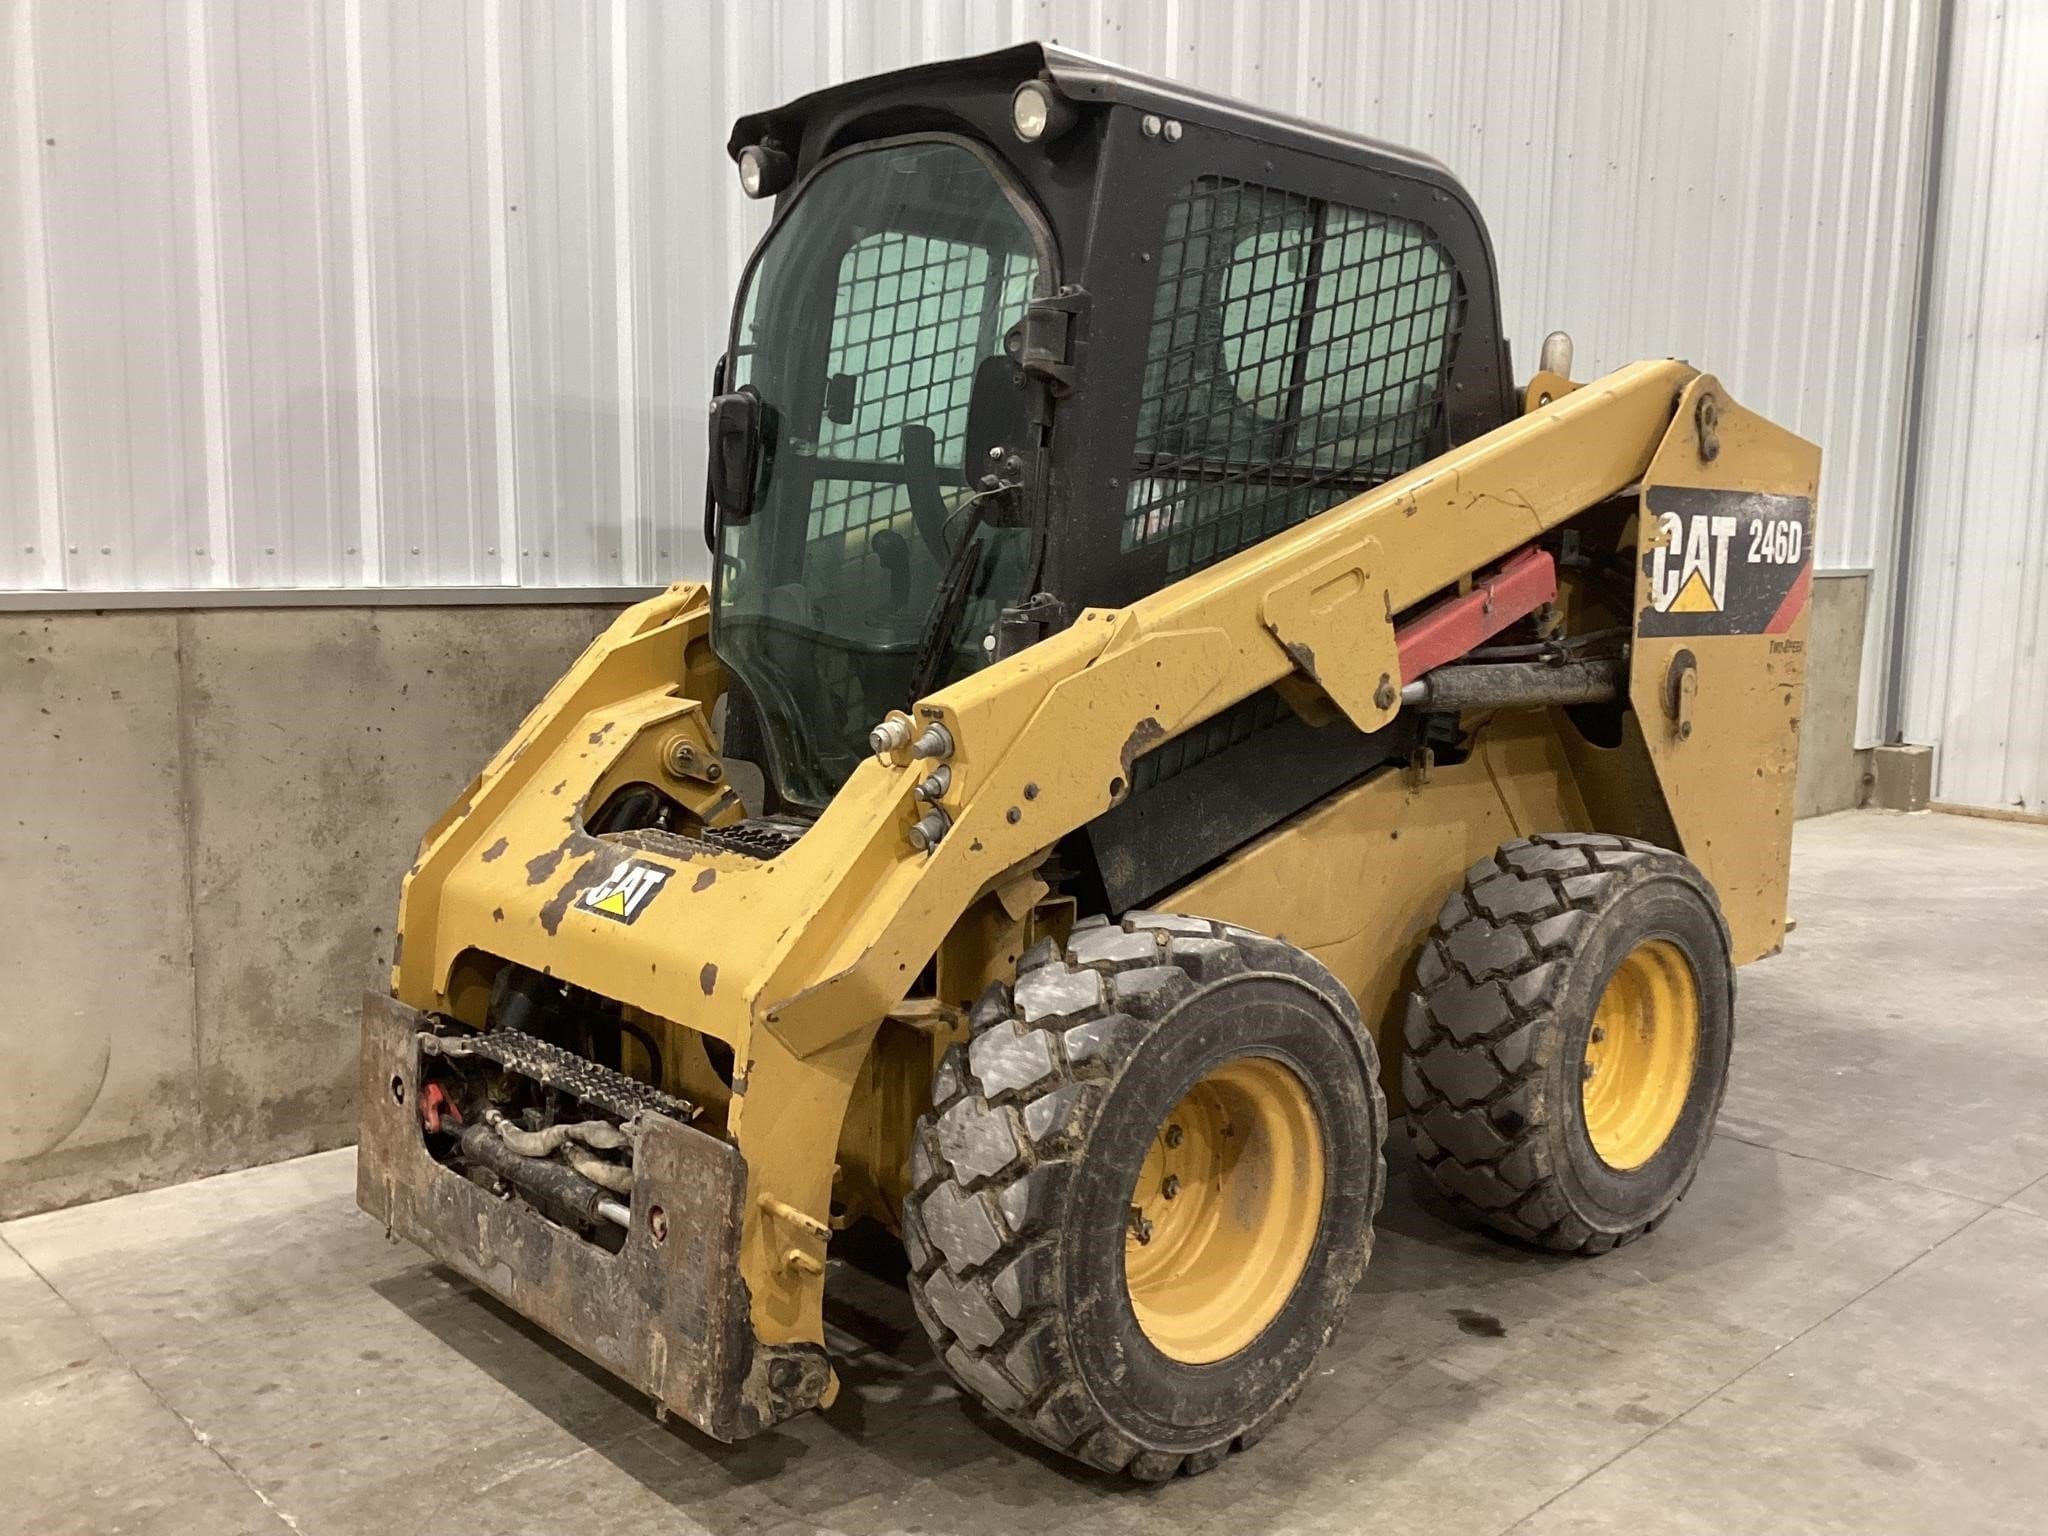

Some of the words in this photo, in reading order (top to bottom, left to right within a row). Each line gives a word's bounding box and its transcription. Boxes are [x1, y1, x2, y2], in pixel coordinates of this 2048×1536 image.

[1652, 511, 1737, 613] CAT
[1747, 518, 1803, 565] 246D
[585, 861, 666, 917] CAT
